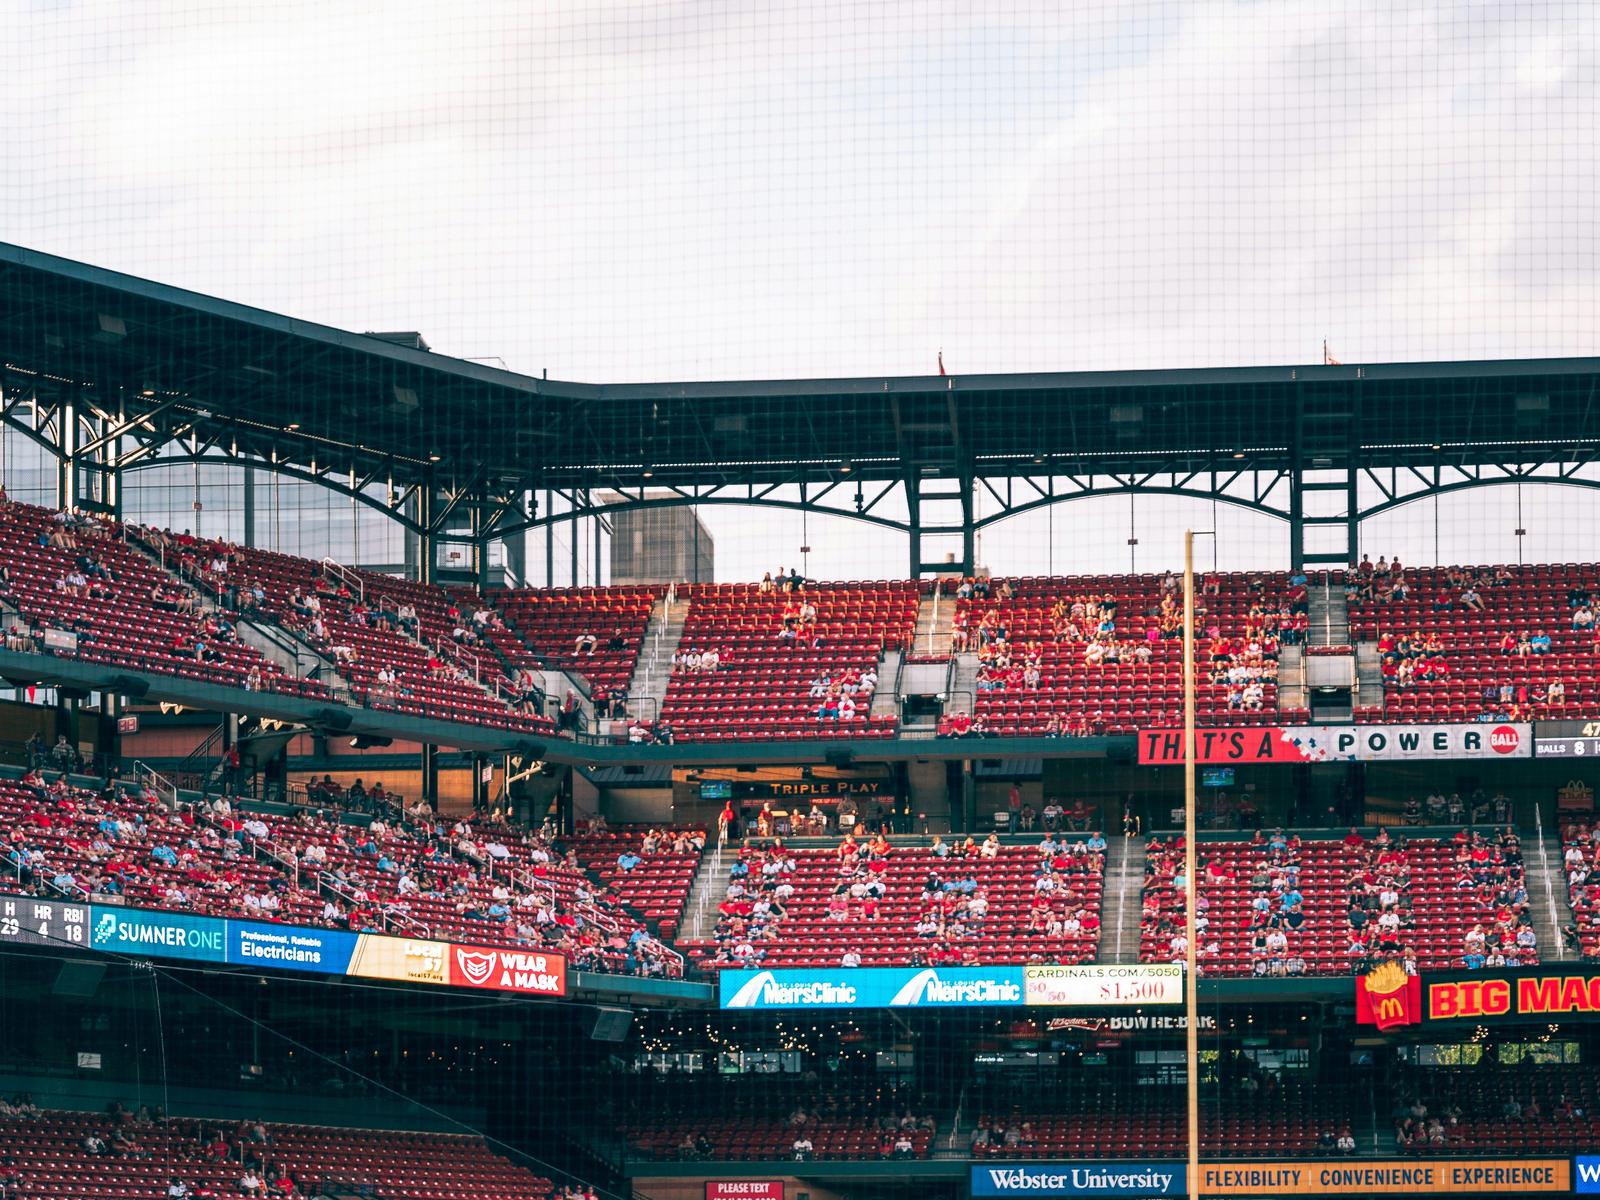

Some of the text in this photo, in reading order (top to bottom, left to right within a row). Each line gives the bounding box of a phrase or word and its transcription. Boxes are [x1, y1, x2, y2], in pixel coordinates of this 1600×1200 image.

[1256, 731, 1273, 758] A
[1338, 731, 1518, 752] POWER BALL
[1537, 744, 1566, 753] BALLS
[1574, 741, 1585, 755] 8
[5, 901, 84, 924] H HR RBI
[0, 917, 19, 935] 29
[64, 924, 82, 942] 18
[241, 941, 321, 963] Electricians
[500, 952, 546, 973] WEAR
[500, 970, 559, 991] A MASK
[1100, 982, 1165, 1003] $1,500
[1429, 979, 1510, 1020] BIG
[988, 1168, 1173, 1193] Webster University
[1206, 1167, 1554, 1186] FLEXIBILITY CONVENIENCE EXPERIENCE
[718, 1183, 769, 1193] PLEASE TEXT
